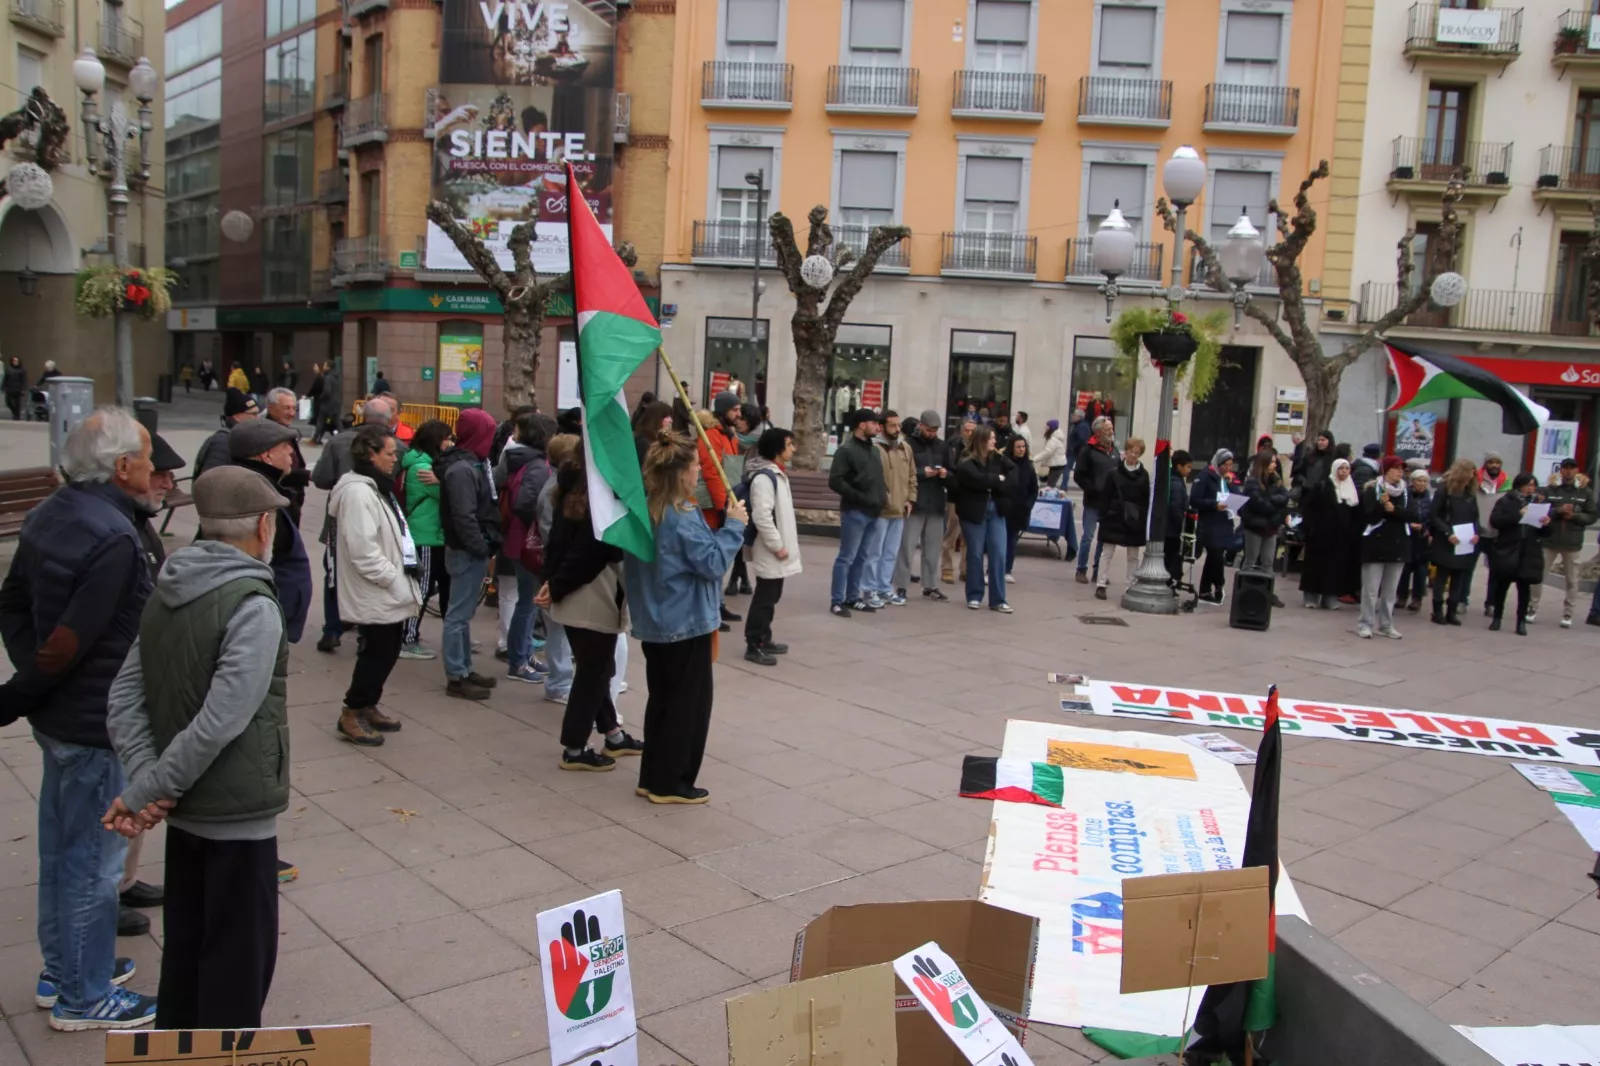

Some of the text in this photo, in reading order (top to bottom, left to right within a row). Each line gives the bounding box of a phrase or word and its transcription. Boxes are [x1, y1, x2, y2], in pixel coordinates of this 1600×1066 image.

[450, 129, 596, 160] SIENTE.
[490, 162, 508, 170] CON
[570, 164, 593, 173] OCAL
[1207, 711, 1302, 732] CON
[1332, 724, 1564, 758] HUESCA
[1031, 811, 1079, 875] Piensa
[590, 936, 624, 962] STOP
[594, 960, 625, 976] PALESTINO
[940, 970, 964, 988] STOP
